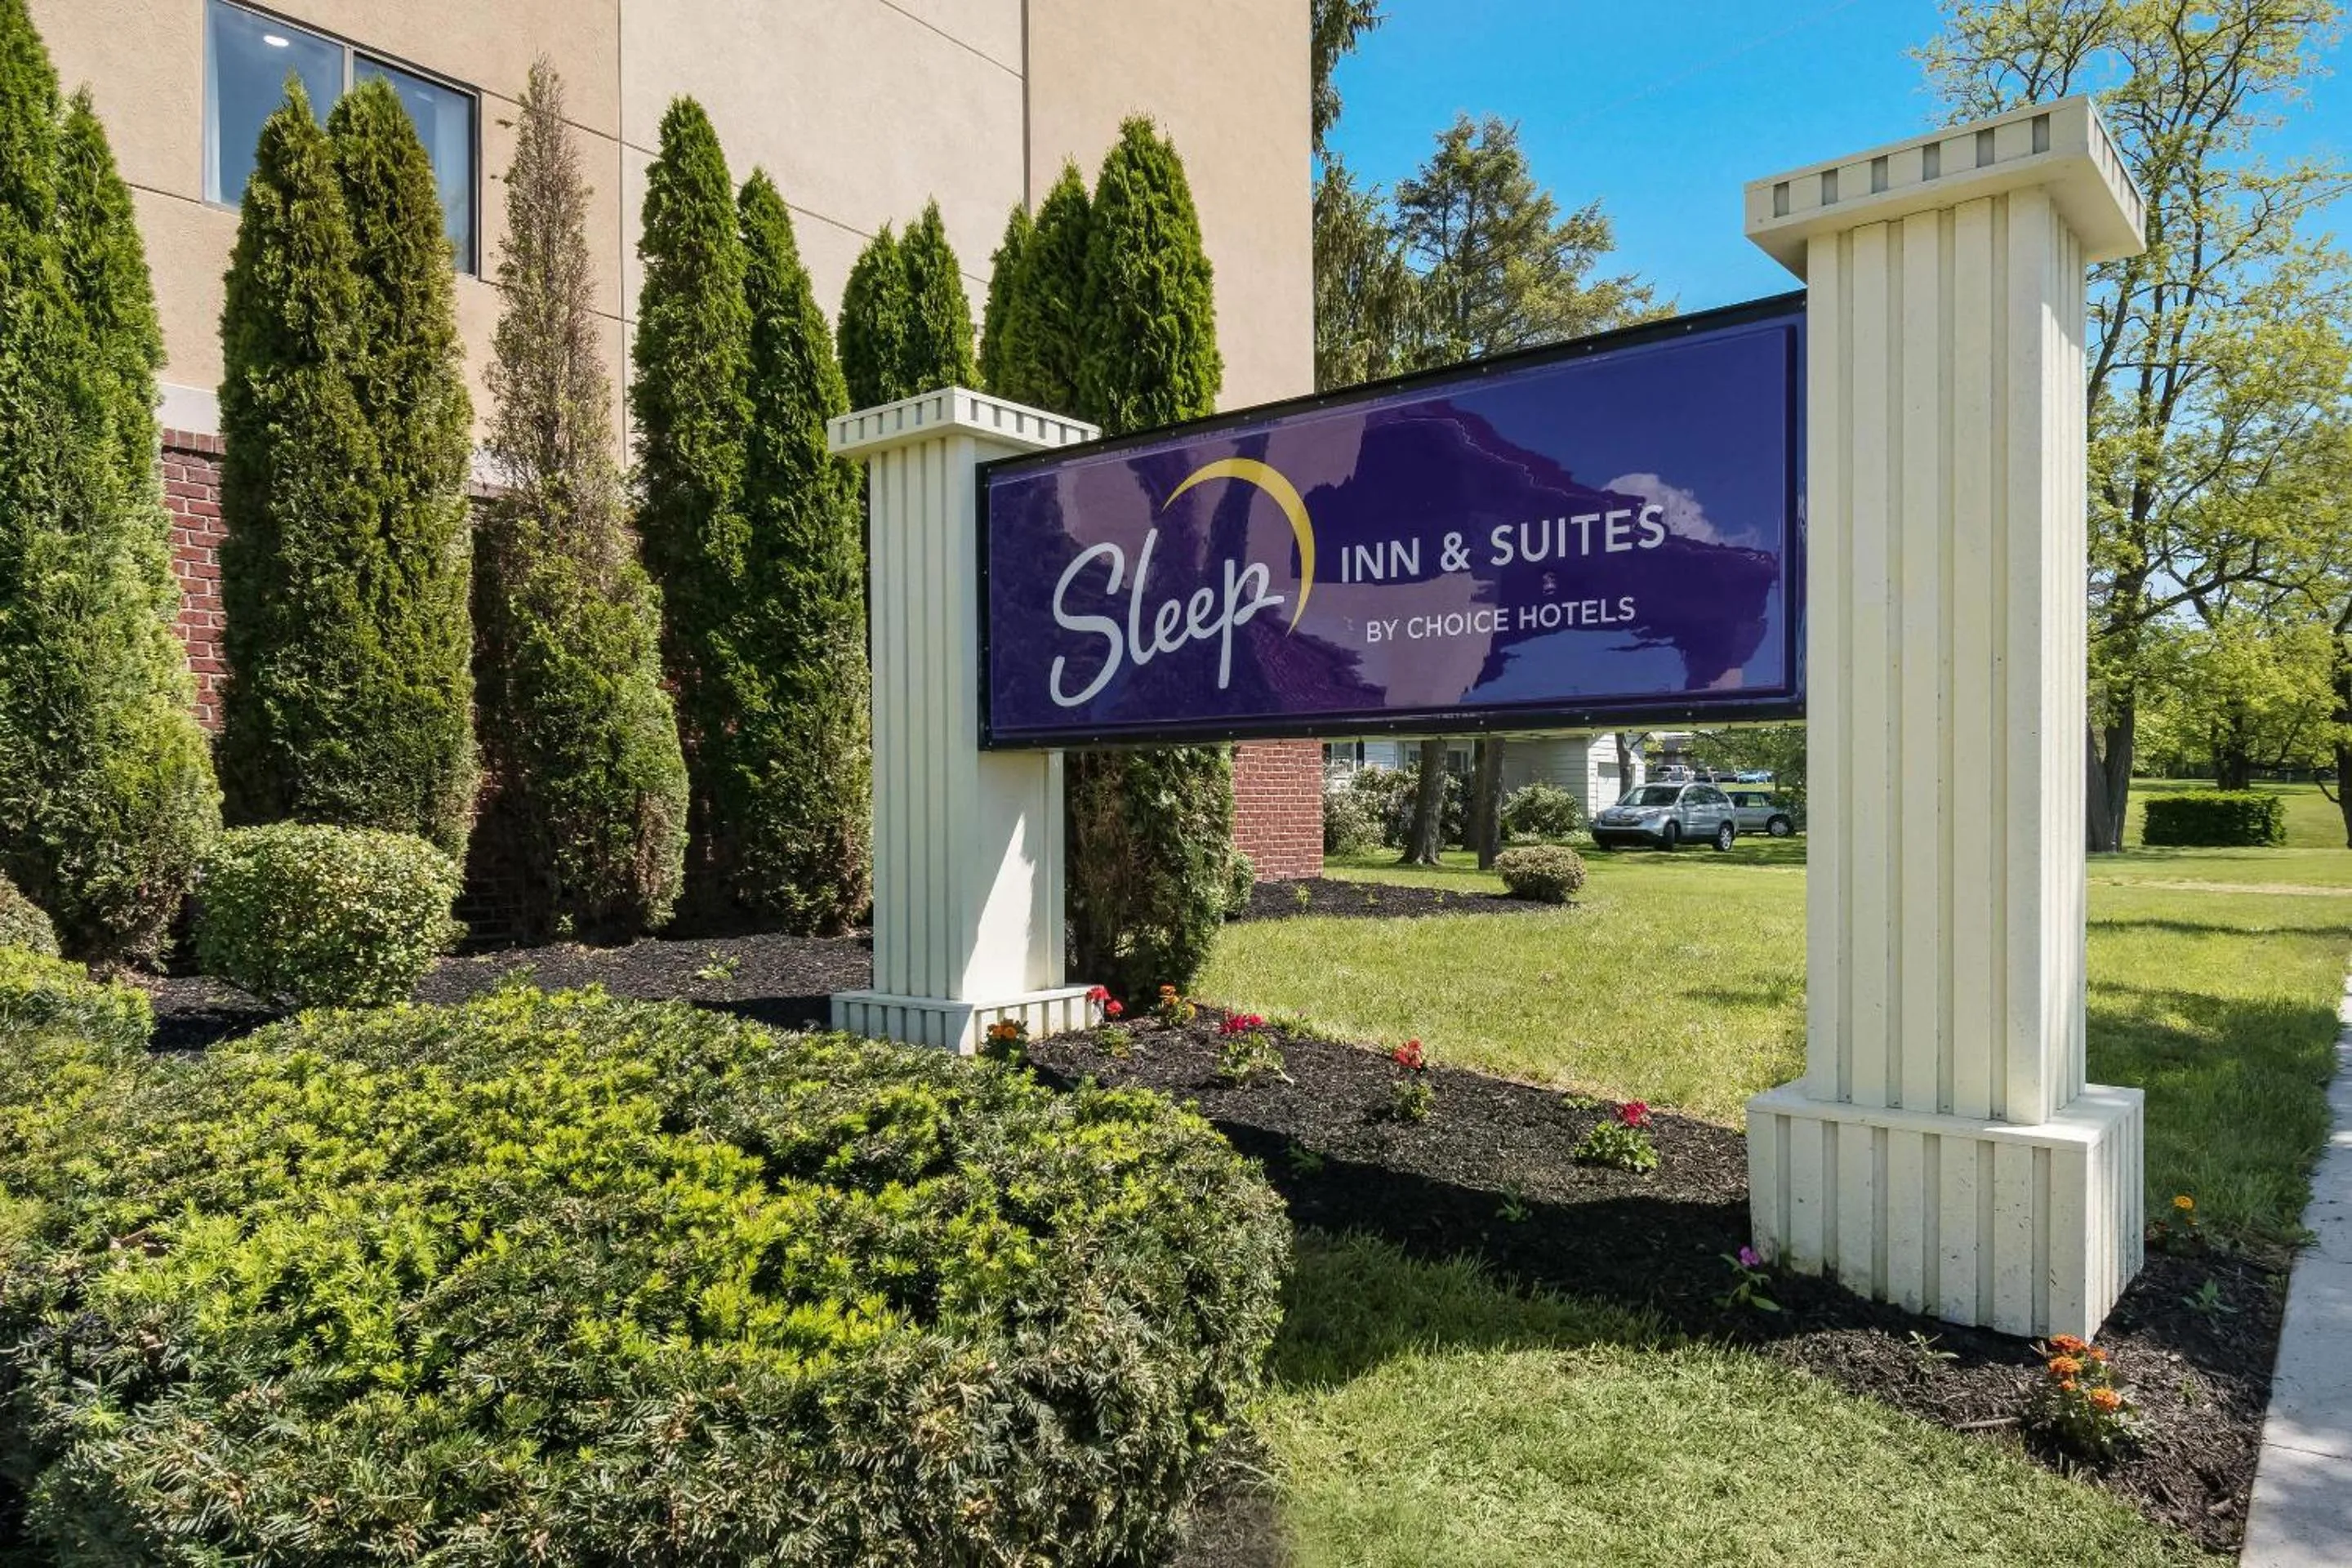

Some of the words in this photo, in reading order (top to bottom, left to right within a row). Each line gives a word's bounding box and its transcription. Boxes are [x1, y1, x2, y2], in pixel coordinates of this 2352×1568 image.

[1341, 537, 1420, 583] INN
[1440, 531, 1471, 572] &
[1490, 504, 1665, 567] SUITES
[1049, 527, 1285, 707] Sleep
[1365, 618, 1400, 644] BY
[1406, 608, 1510, 640] CHOICE
[1518, 596, 1636, 630] HOTELS
